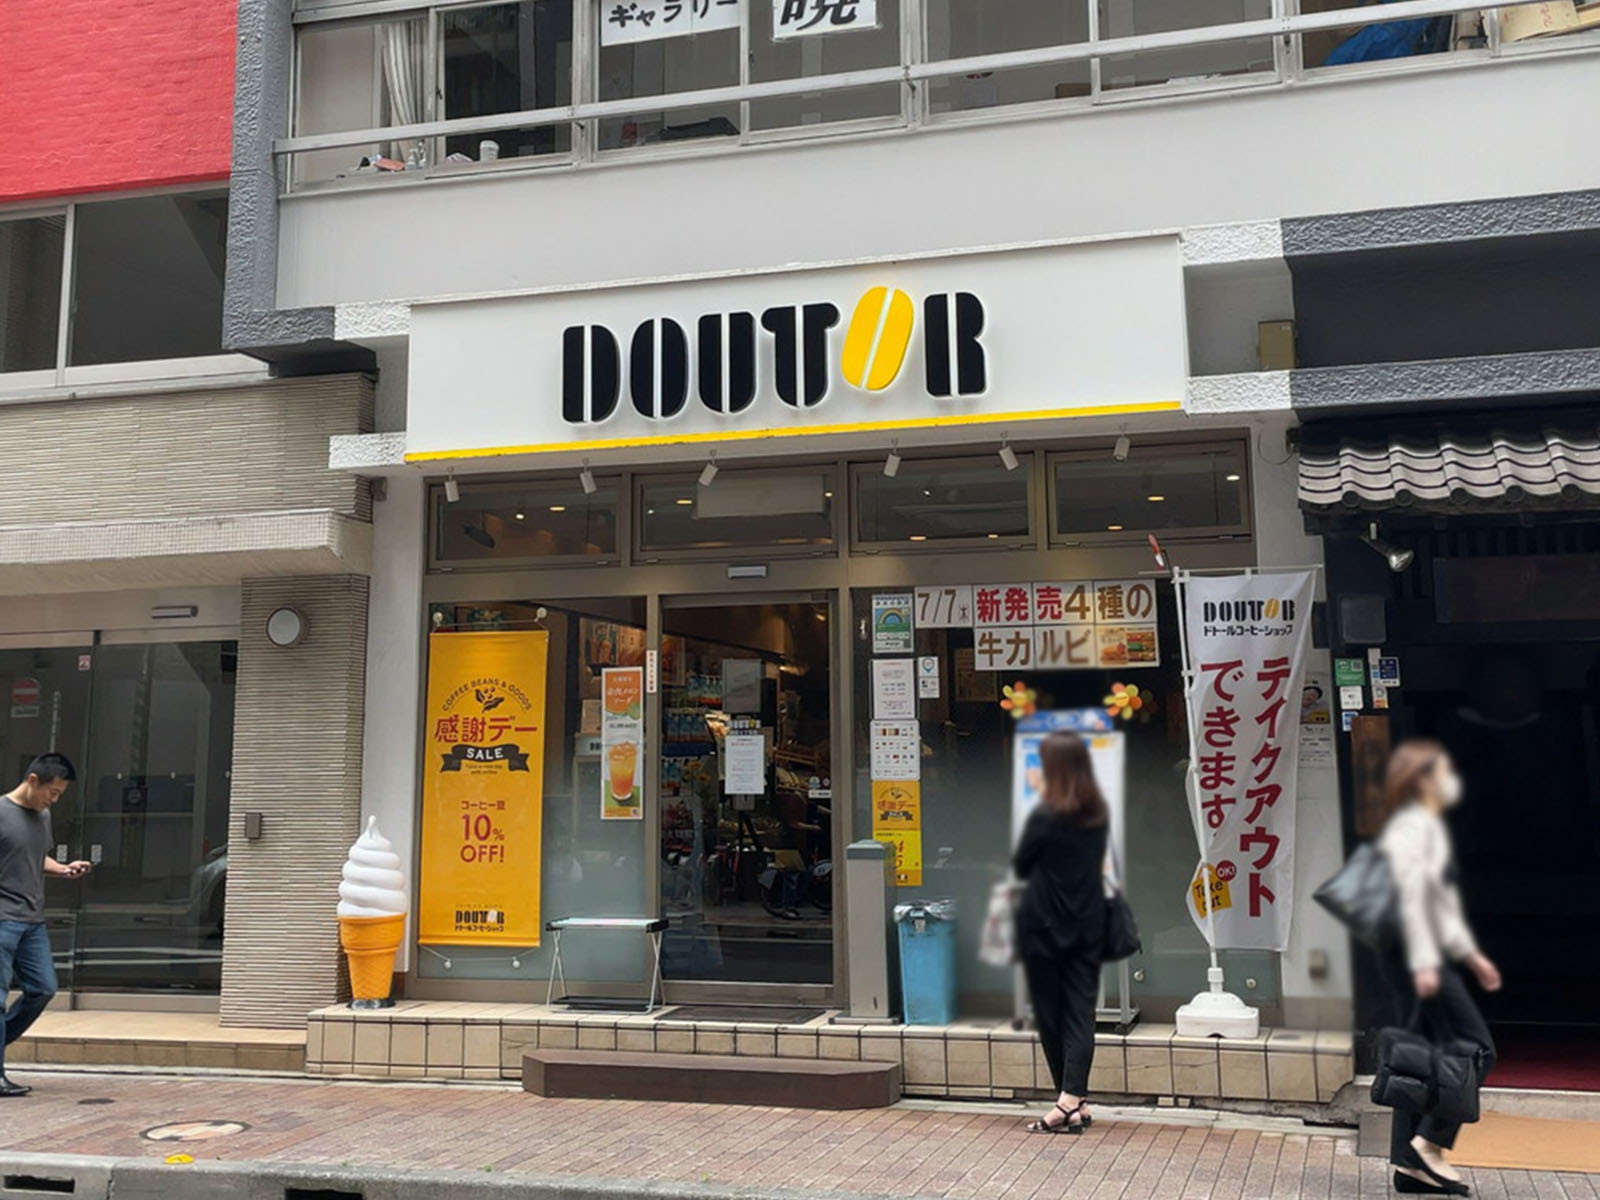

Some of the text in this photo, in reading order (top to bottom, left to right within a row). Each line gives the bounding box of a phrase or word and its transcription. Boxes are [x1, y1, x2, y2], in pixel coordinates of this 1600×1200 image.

[609, 0, 738, 27] ギャラリー
[562, 286, 987, 423] DOUTOR
[977, 583, 1153, 623] 新発売4種の
[1203, 598, 1295, 622] DOUTOR
[1204, 624, 1293, 636] ドトールコーヒーショップ
[977, 629, 1091, 667] 牛カルビ
[441, 683, 469, 712] COFFEE
[471, 678, 500, 688] BEANS
[508, 684, 533, 711] GOODS
[434, 714, 538, 743] 感謝デー
[466, 747, 504, 760] SALE
[1199, 659, 1244, 829] できます
[1239, 656, 1291, 917] テイクアウト
[461, 813, 505, 841] 10%
[460, 845, 505, 863] OFF!
[455, 909, 505, 924] DOUTOR
